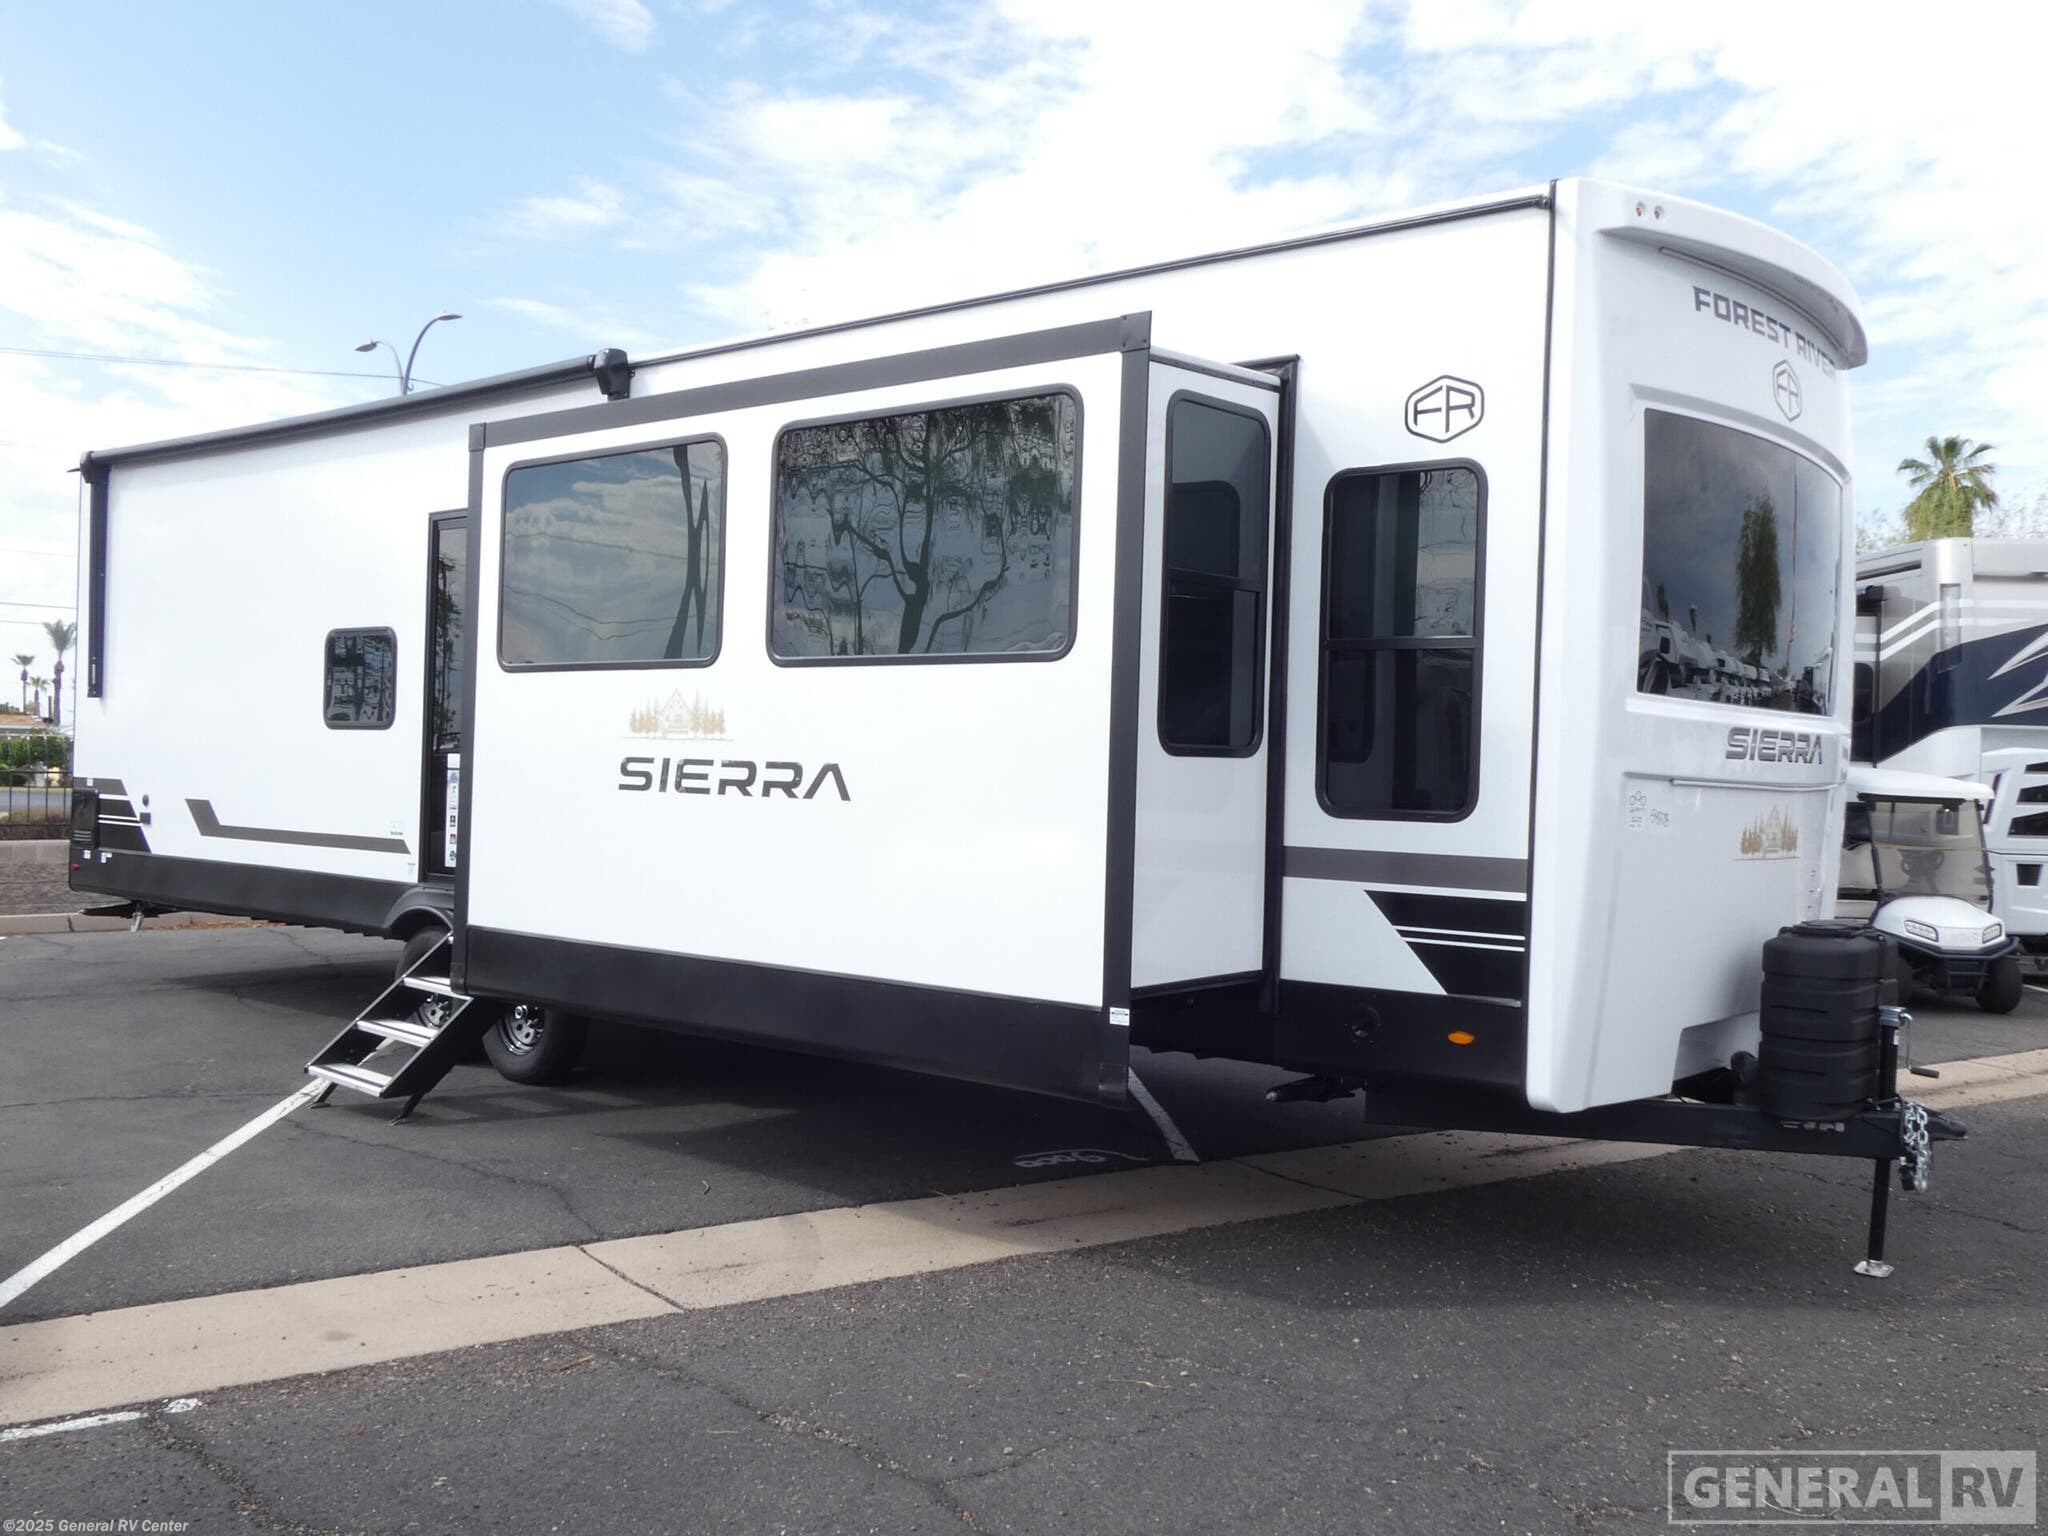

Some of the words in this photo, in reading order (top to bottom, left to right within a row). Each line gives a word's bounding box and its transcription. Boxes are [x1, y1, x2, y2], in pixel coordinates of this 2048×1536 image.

[1693, 286, 1791, 348] FOREST
[1411, 382, 1477, 435] FR
[1725, 726, 1822, 765] SIERRA
[618, 756, 852, 802] SIERRA
